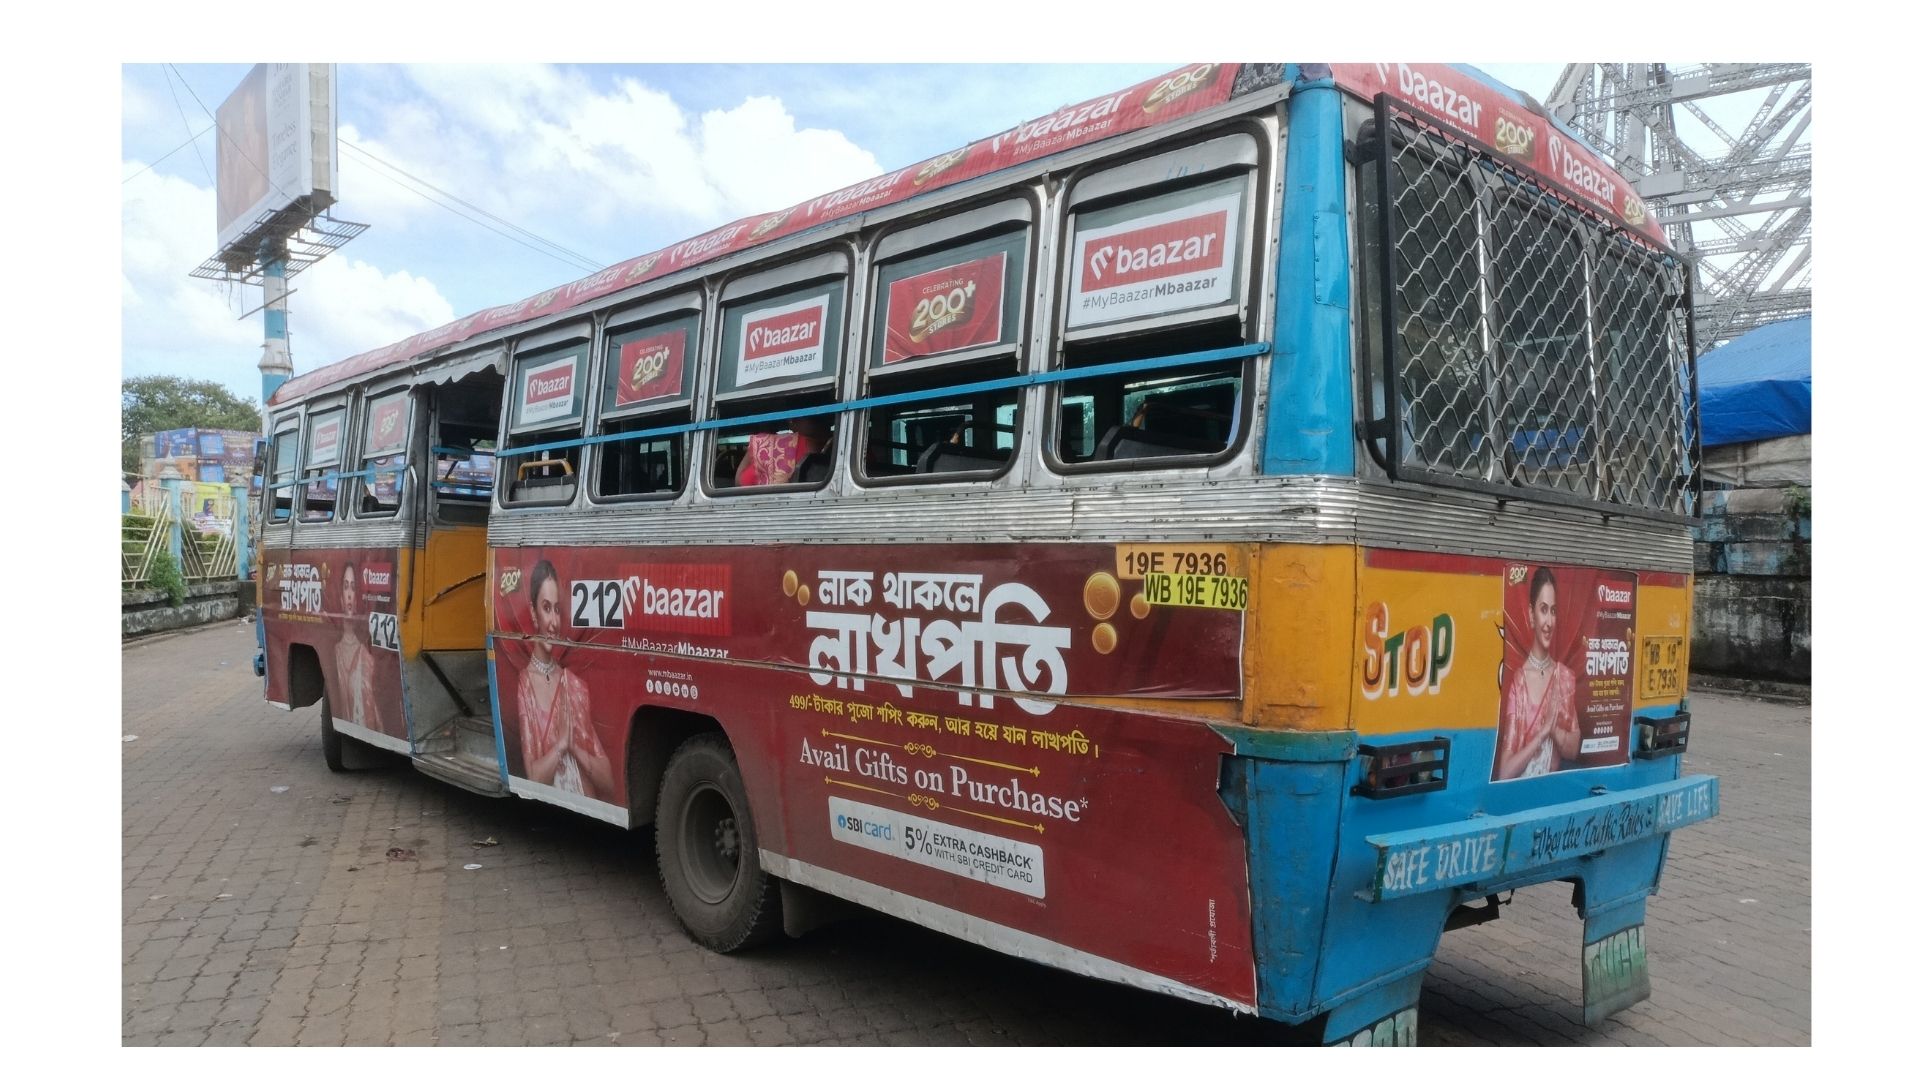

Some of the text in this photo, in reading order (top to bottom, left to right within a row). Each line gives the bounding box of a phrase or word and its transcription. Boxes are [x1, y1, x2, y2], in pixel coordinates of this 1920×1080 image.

[922, 277, 964, 294] CELEBRATING
[1083, 276, 1217, 310] #MyBaazarMbaazar
[1125, 552, 1226, 577] 19E 7936
[572, 581, 623, 627] 212
[818, 570, 984, 614] লাক থাকলে
[1145, 574, 1248, 609] WB 19E 7936
[370, 613, 398, 649] 212
[806, 582, 1072, 715] লাখপতি
[1362, 601, 1456, 700] STOP
[647, 669, 693, 682] www.mbaazar.in
[944, 716, 971, 736] আর
[799, 737, 850, 772] Avail
[855, 748, 907, 785] Gifts
[914, 770, 945, 793] on
[847, 816, 892, 841] SBI card
[905, 826, 933, 856] 5%
[933, 833, 967, 853] EXTRA
[934, 848, 1033, 884] WITH SBI CREDIT CARD
[1383, 833, 1498, 890] SAFE DRIVE
